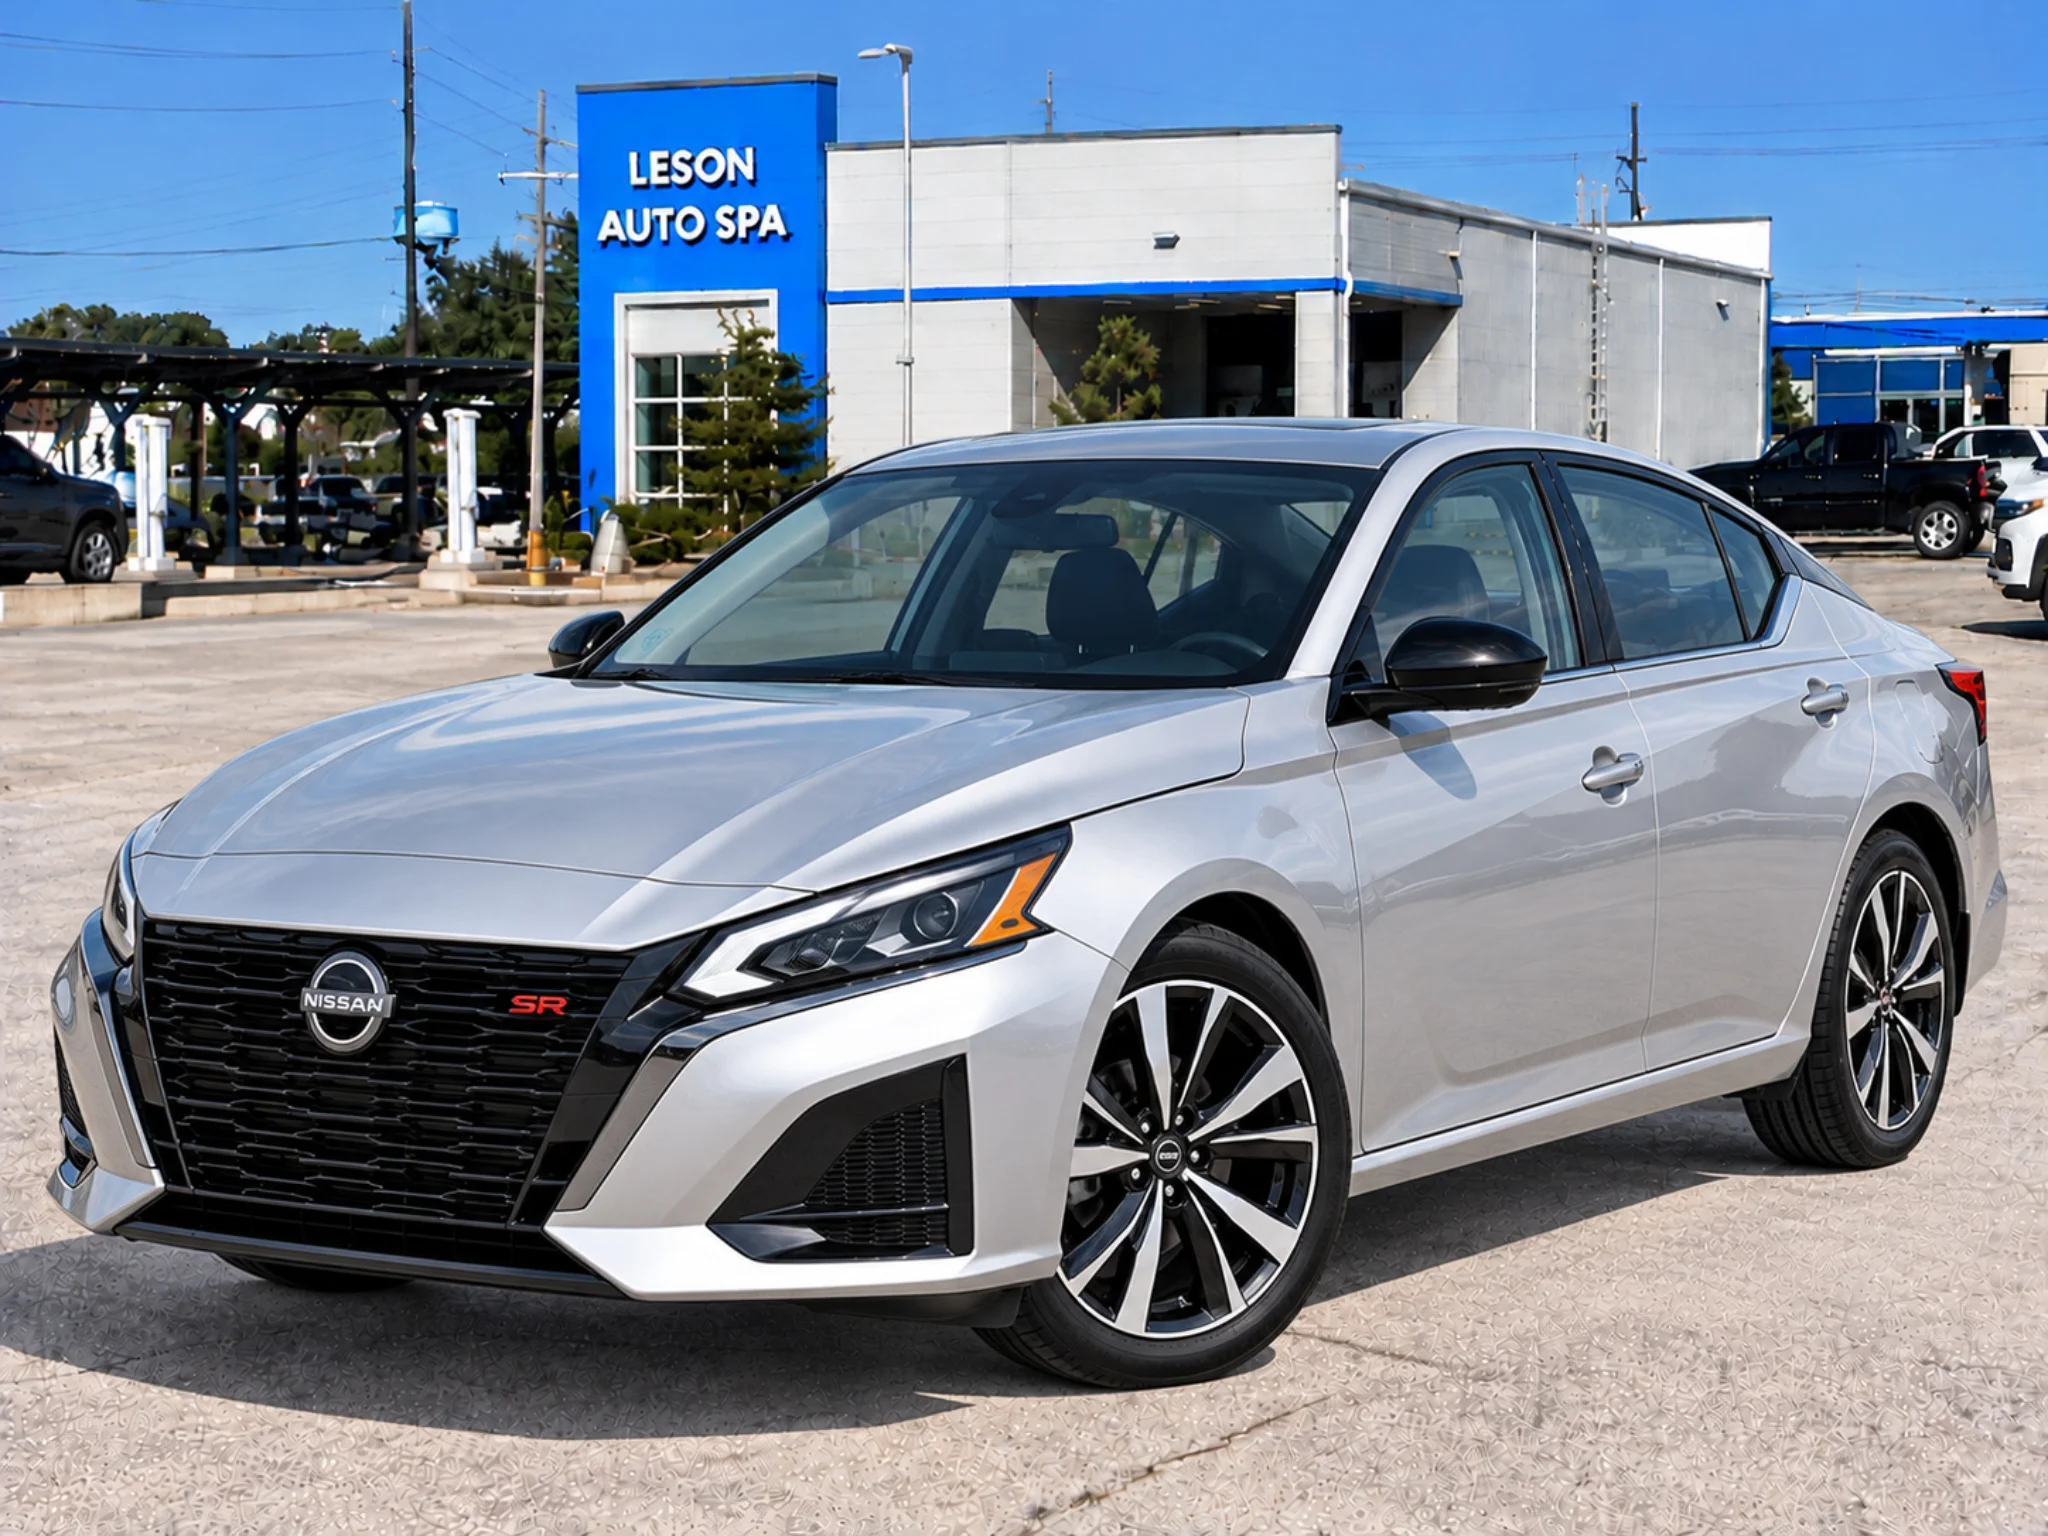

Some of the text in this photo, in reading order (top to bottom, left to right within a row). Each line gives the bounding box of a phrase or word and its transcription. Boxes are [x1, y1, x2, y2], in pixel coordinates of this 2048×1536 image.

[629, 146, 755, 187] LESON
[597, 204, 788, 243] AUTO SPA
[303, 992, 384, 1013] NISSAN
[508, 994, 568, 1016] SR
